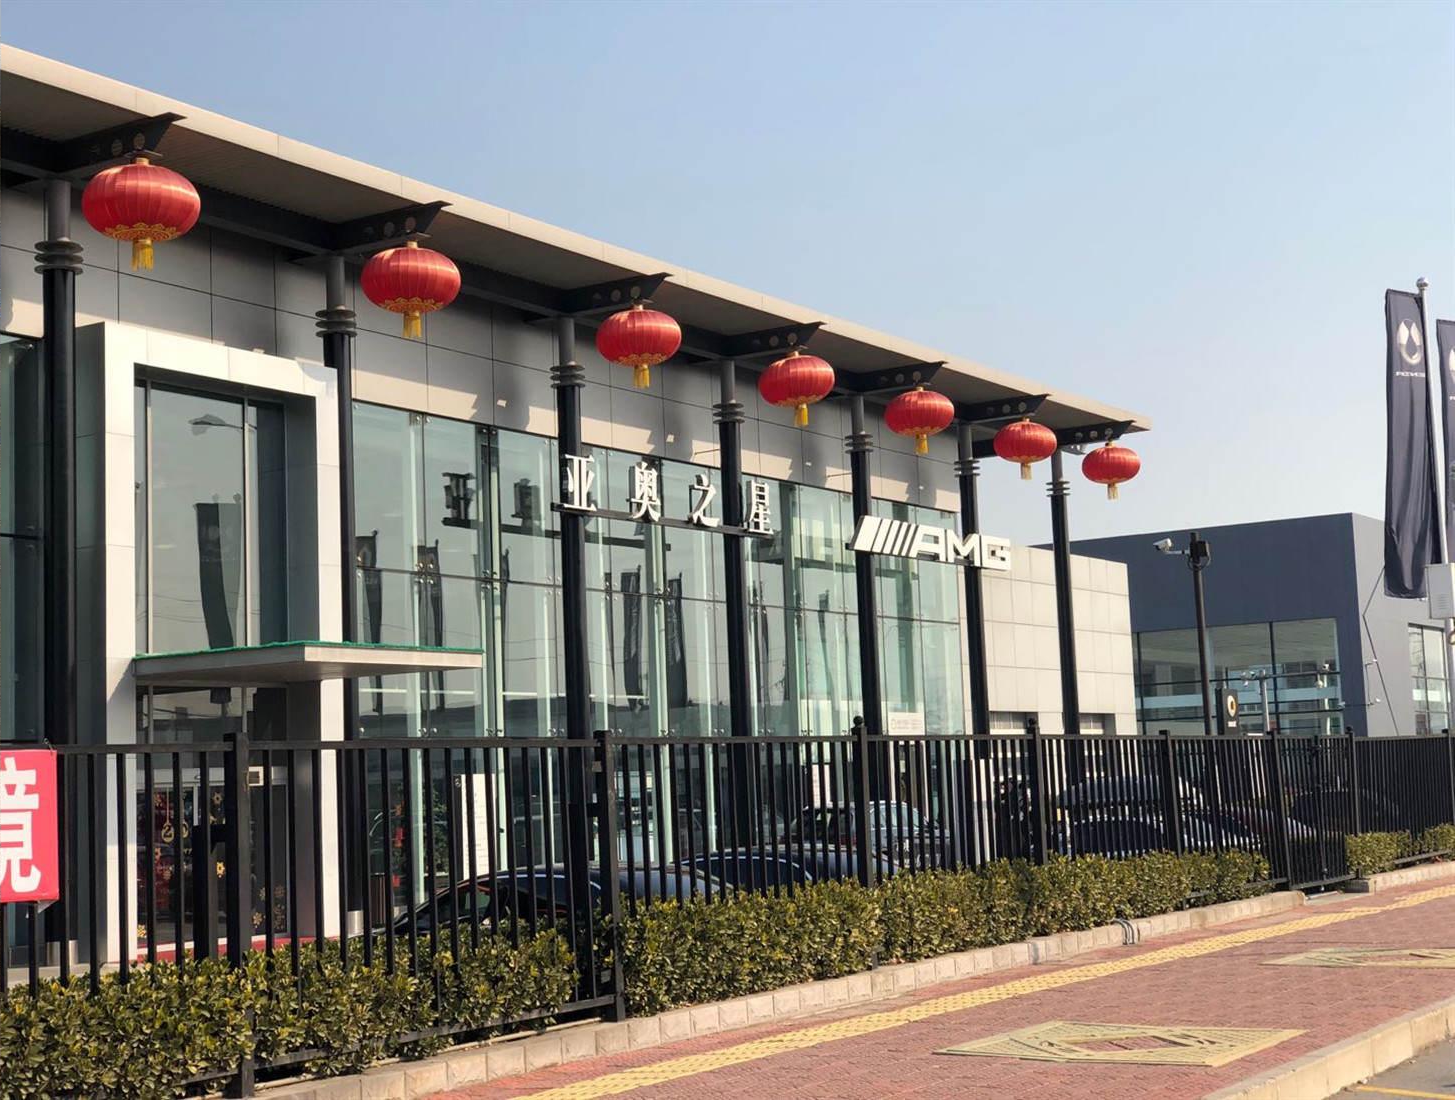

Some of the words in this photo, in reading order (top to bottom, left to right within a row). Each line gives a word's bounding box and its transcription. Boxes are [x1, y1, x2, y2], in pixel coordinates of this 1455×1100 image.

[562, 453, 775, 535] 亚奥之星
[908, 524, 1011, 570] AMG
